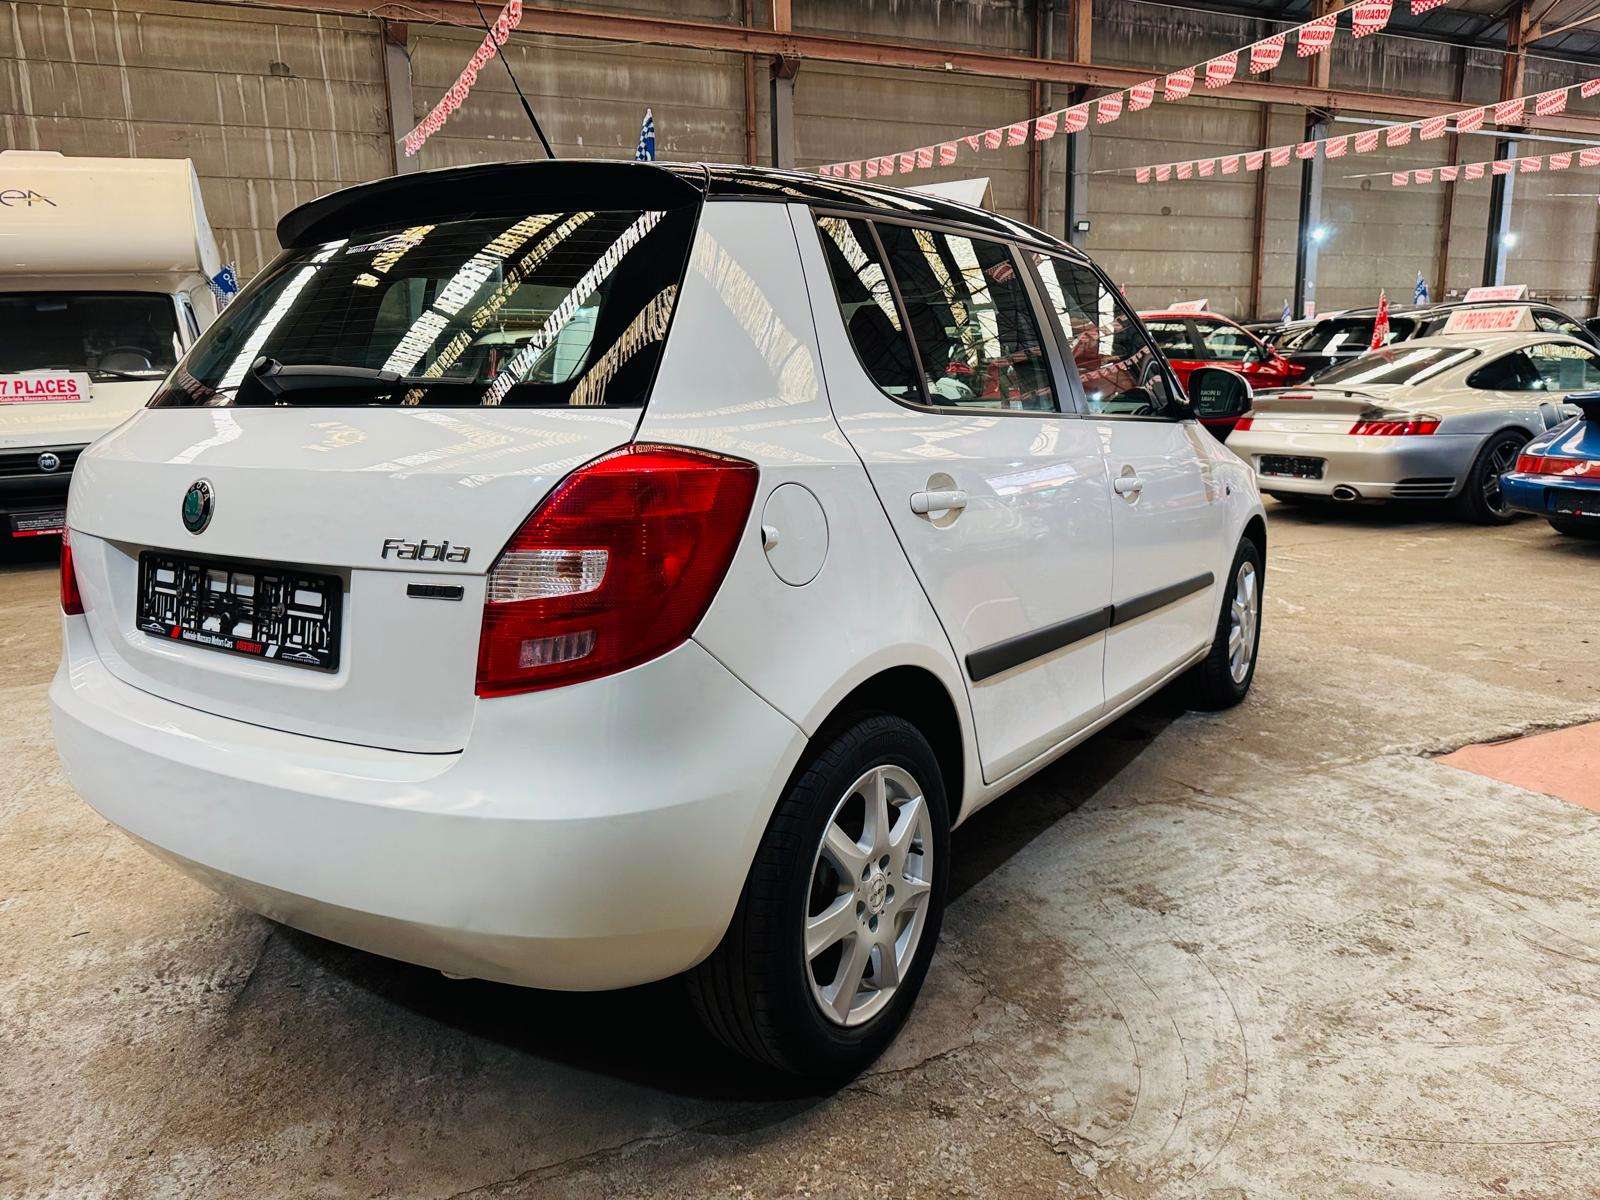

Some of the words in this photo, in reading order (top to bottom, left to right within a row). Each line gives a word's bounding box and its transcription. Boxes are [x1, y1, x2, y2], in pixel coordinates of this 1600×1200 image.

[1496, 102, 1523, 121] OCCASION
[1537, 93, 1566, 112] OCCASION
[0, 381, 8, 395] 7
[14, 379, 77, 394] PLACES
[381, 538, 471, 563] Fabia
[224, 638, 233, 648] Cars
